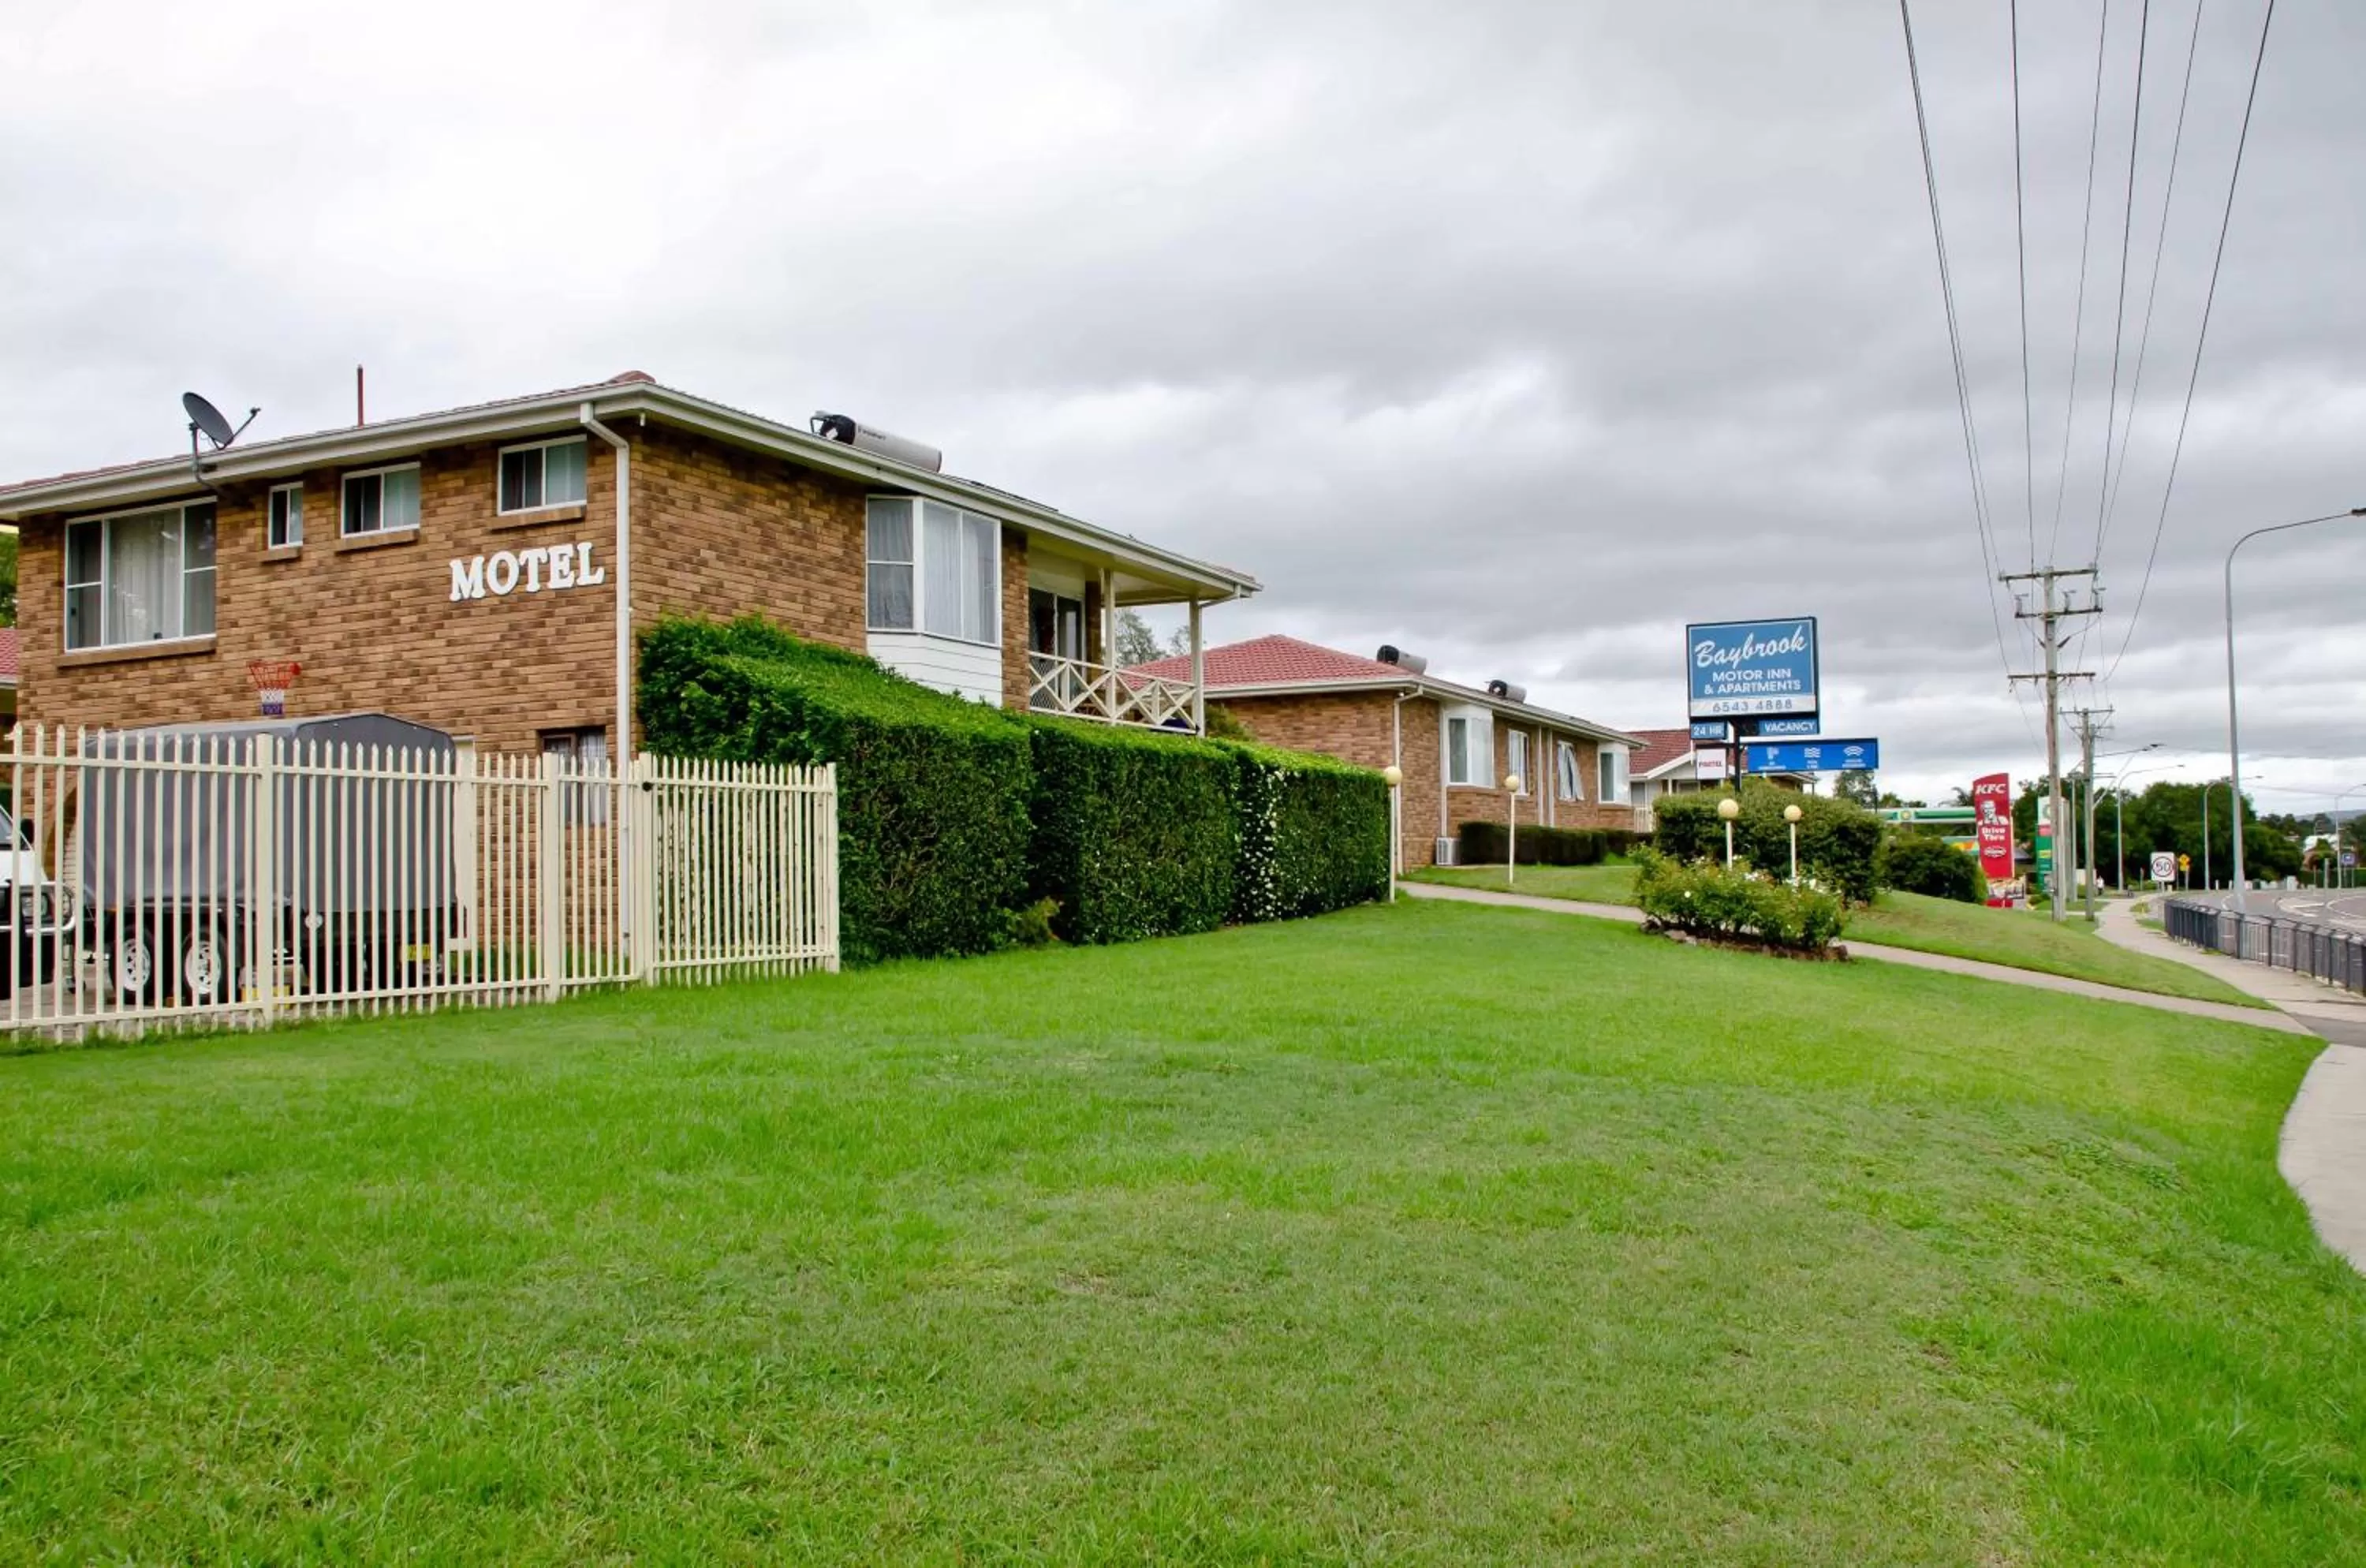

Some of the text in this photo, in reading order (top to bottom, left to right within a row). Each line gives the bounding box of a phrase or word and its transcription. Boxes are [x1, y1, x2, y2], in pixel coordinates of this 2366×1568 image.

[450, 542, 605, 602] MOTEL
[1695, 625, 1808, 669] Baybrook
[1712, 668, 1791, 682] MOTOR INN
[1704, 679, 1801, 695] & APARTMENTS
[1712, 698, 1793, 712] 6543 4888
[1693, 726, 1706, 736] 24
[1764, 721, 1815, 733] VACANCY
[1975, 783, 2007, 795] KFC
[1982, 827, 2006, 835] Drive
[2155, 861, 2171, 873] 50
